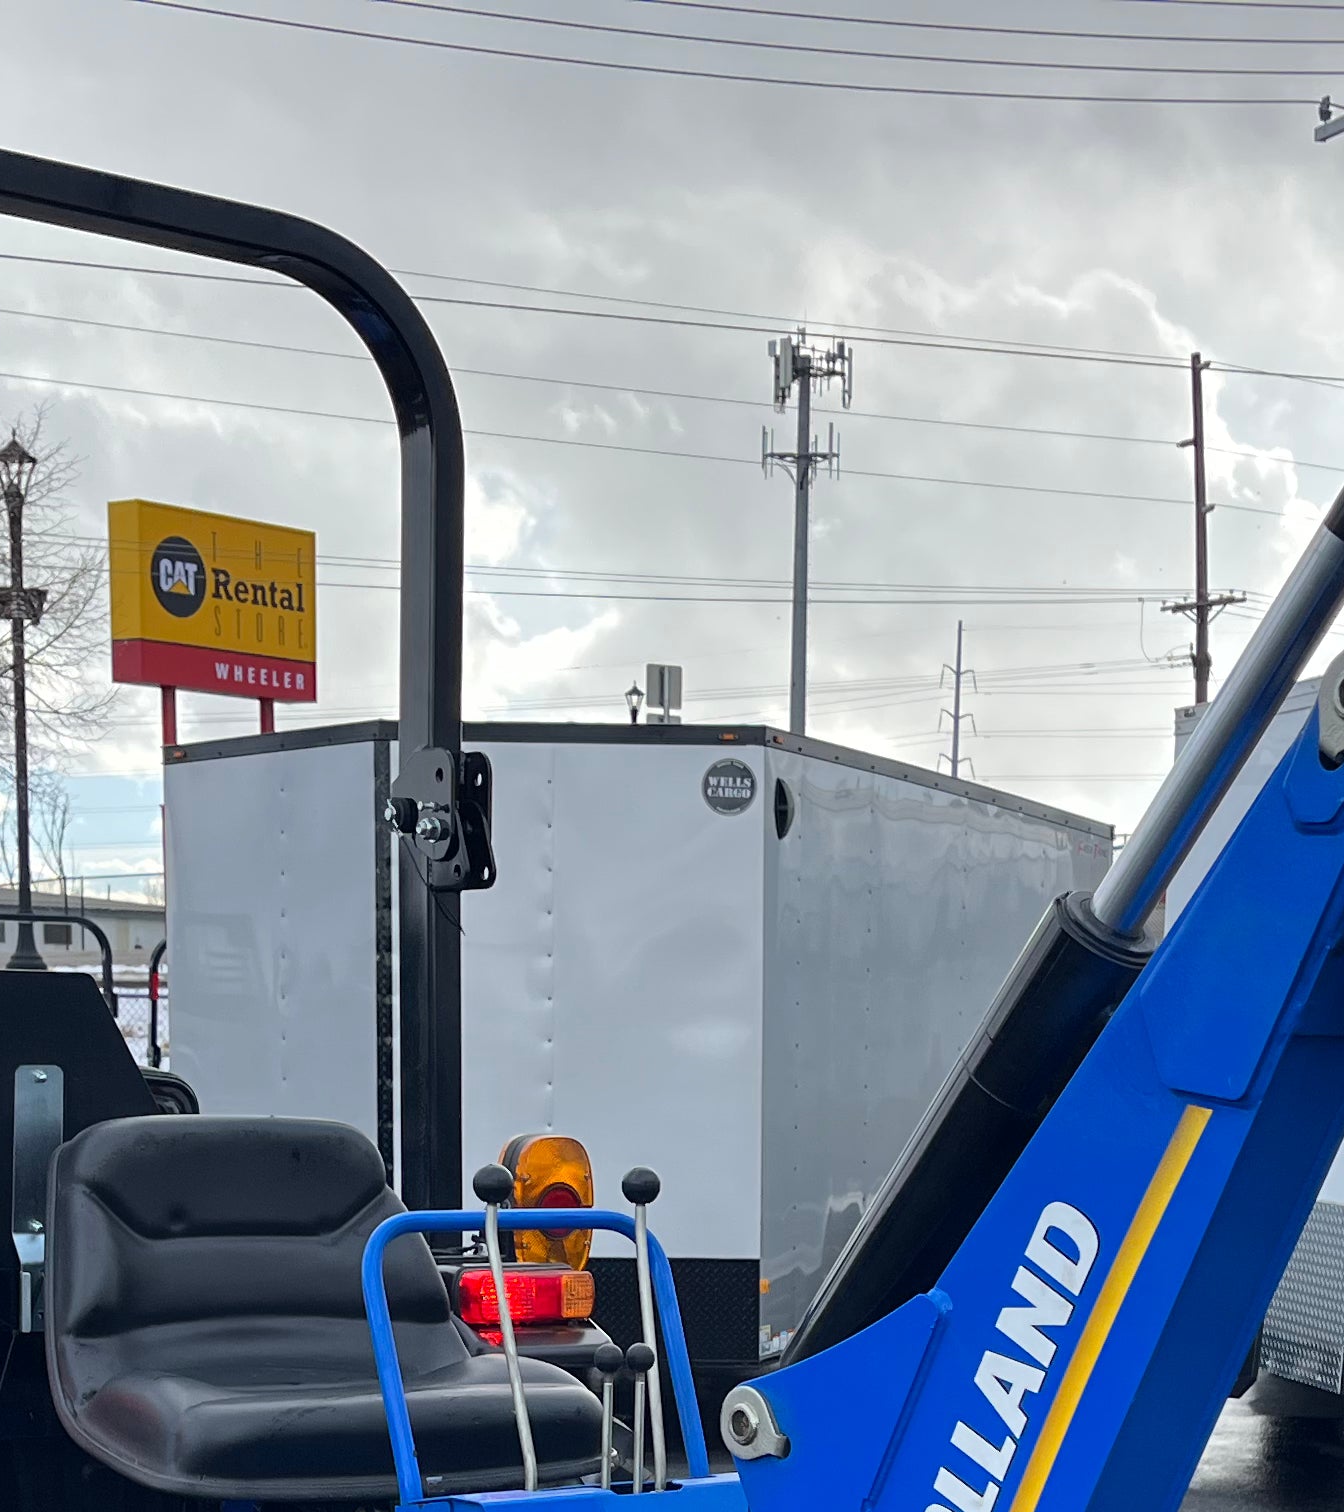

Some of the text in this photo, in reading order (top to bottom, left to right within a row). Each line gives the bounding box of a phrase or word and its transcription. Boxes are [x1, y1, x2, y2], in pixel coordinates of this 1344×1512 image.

[211, 531, 303, 579] THE
[159, 558, 198, 596] CAT
[211, 567, 305, 613] Rental
[212, 605, 304, 648] STORE
[215, 662, 305, 690] WHEELER
[707, 787, 751, 799] CARGO
[708, 776, 752, 788] WELLS
